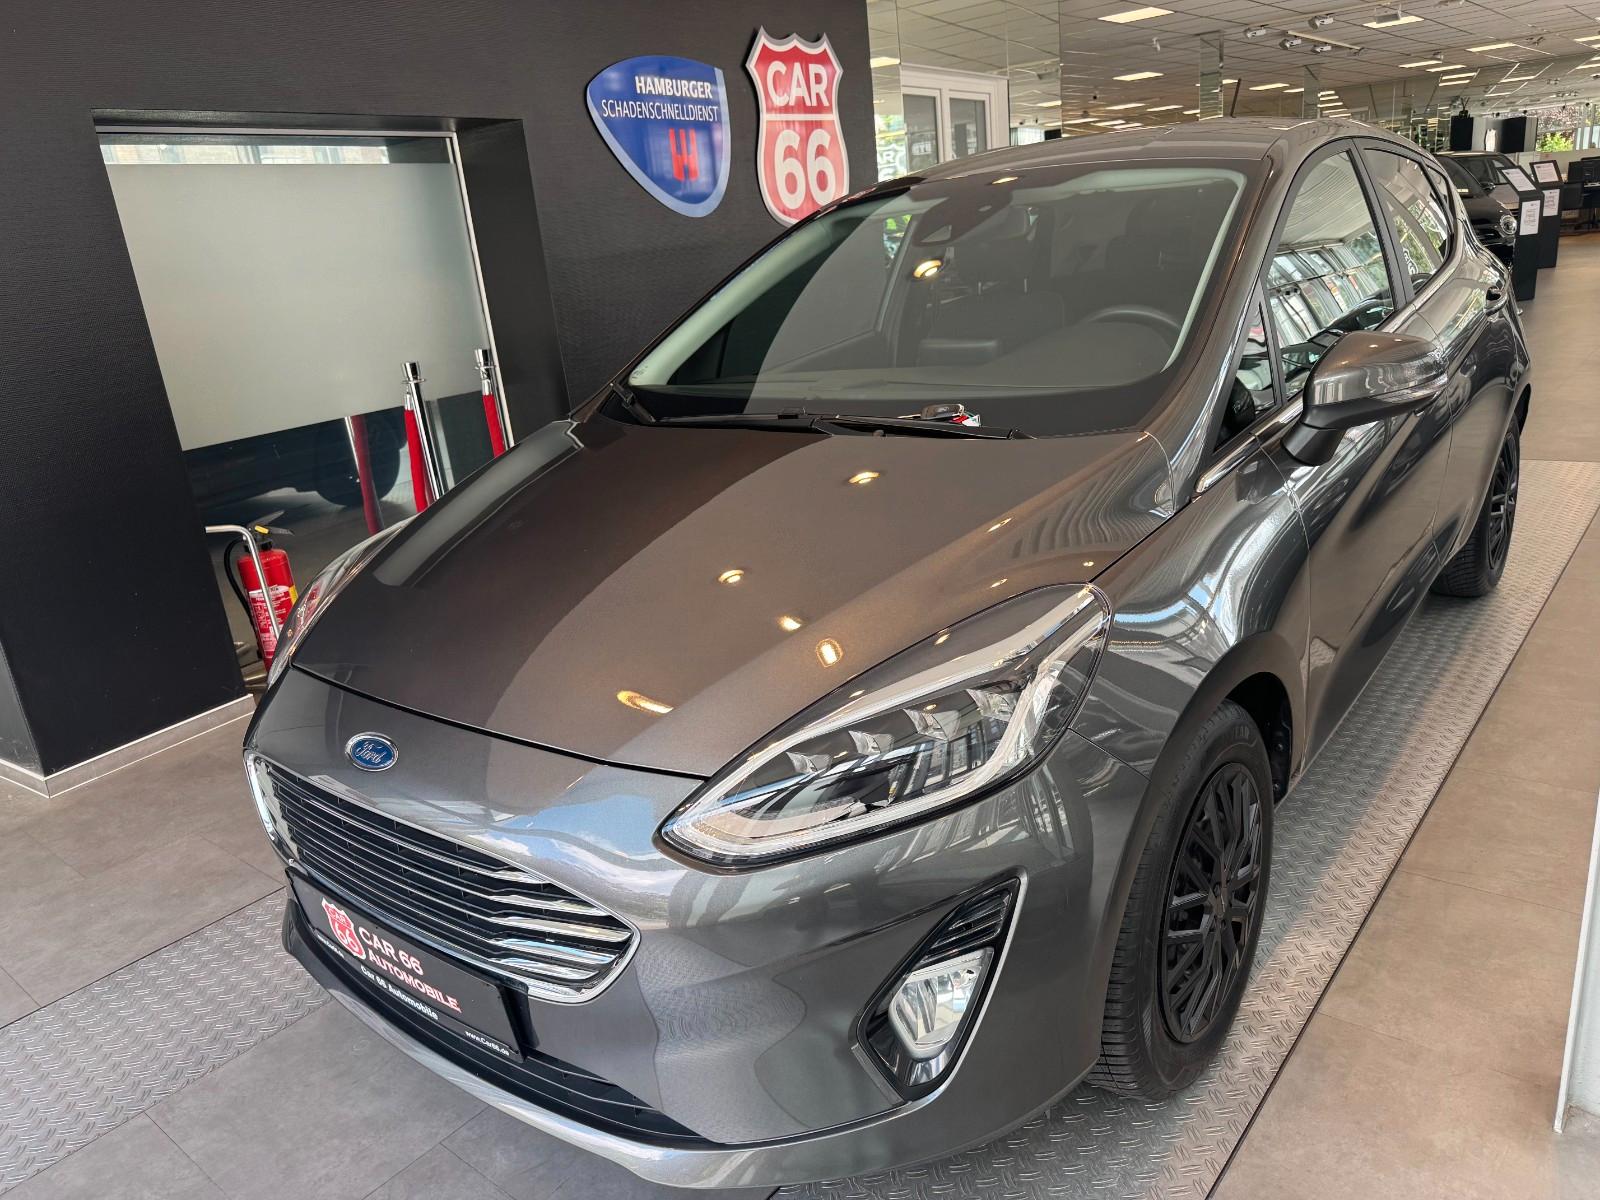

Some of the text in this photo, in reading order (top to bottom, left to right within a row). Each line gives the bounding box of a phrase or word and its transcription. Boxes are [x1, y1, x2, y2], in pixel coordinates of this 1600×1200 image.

[634, 76, 713, 99] HAMBURGER
[766, 60, 830, 107] CAR
[601, 99, 719, 122] SCHADENSCHNELLDIENST
[774, 128, 836, 210] 66
[358, 926, 399, 963] CAR
[398, 949, 425, 976] 66
[367, 947, 463, 1014] AUTOMOBILE
